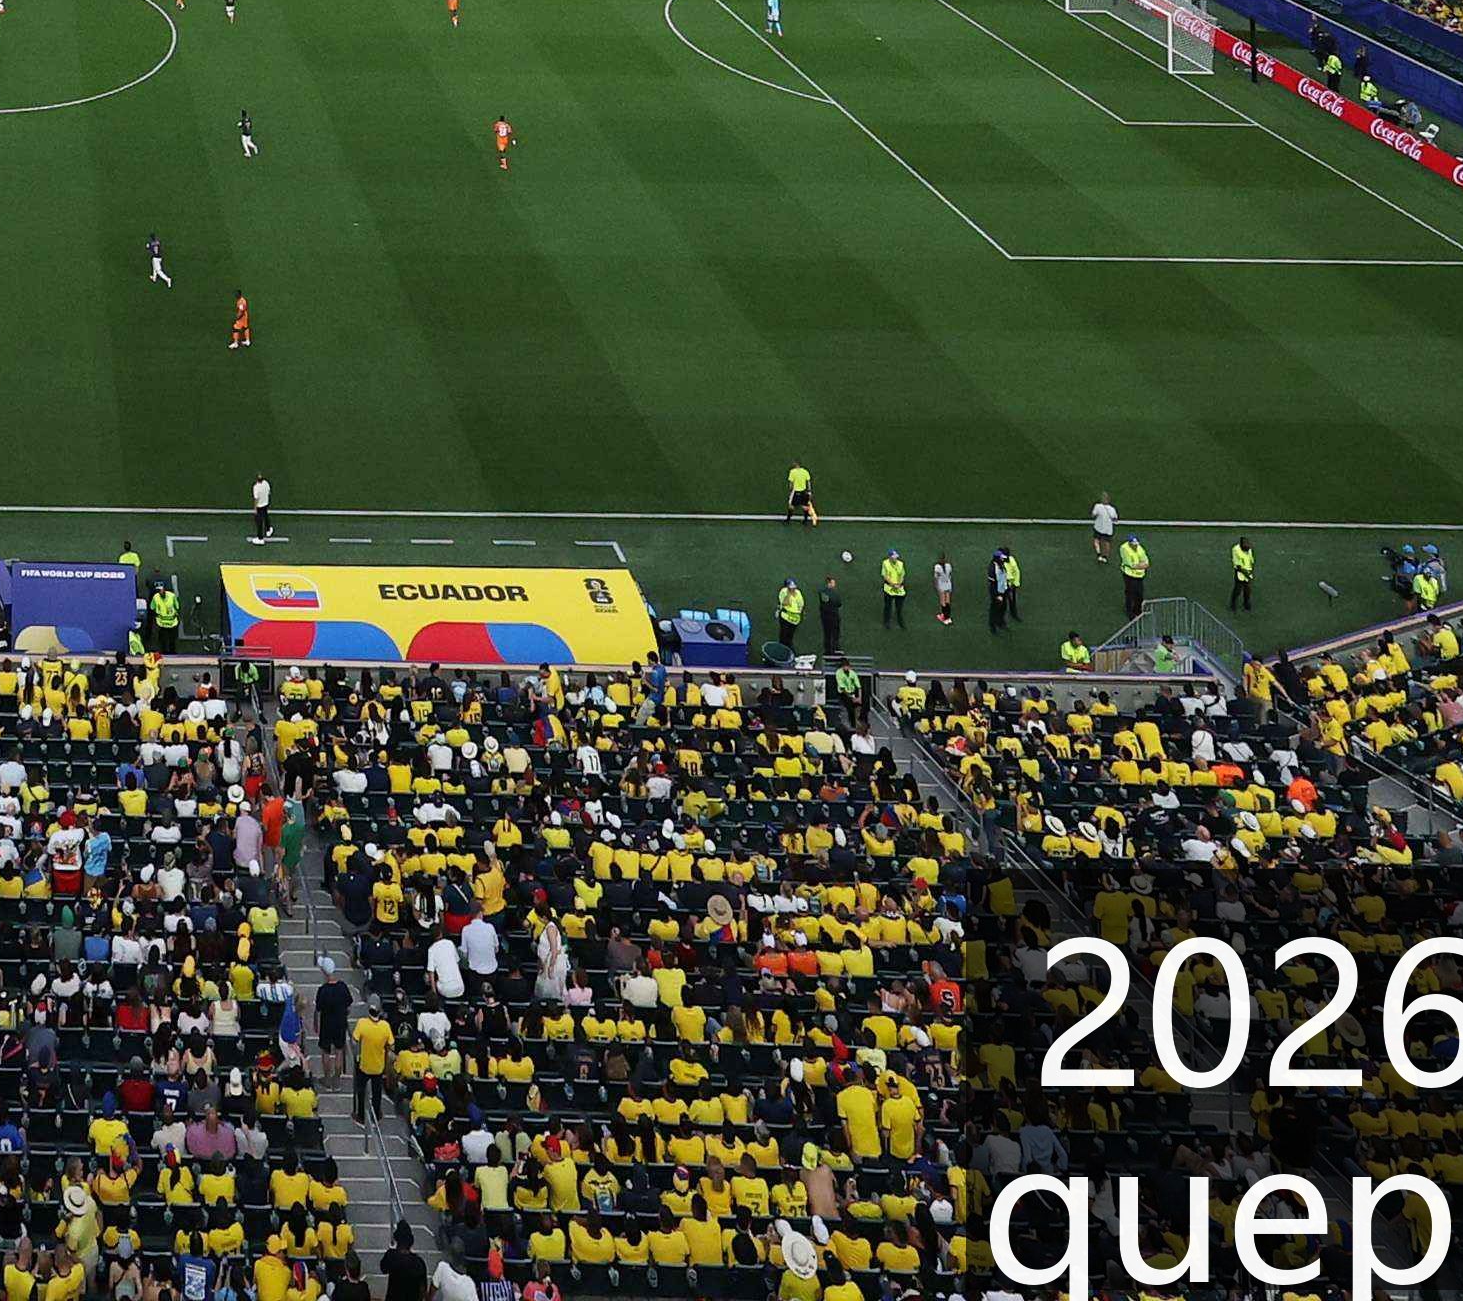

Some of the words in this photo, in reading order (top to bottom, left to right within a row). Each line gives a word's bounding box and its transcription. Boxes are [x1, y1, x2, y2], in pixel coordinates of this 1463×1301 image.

[1297, 76, 1344, 118] Coca-Cola
[1370, 118, 1423, 162] Coca-Cola
[21, 569, 41, 578] FIFA
[41, 570, 73, 578] WORLD
[74, 571, 94, 579] CUP
[93, 571, 126, 579] 2026
[378, 583, 529, 602] ECUADOR
[115, 671, 128, 686] 23
[907, 695, 923, 710] 25
[383, 900, 396, 915] 12
[167, 1098, 177, 1114] 7
